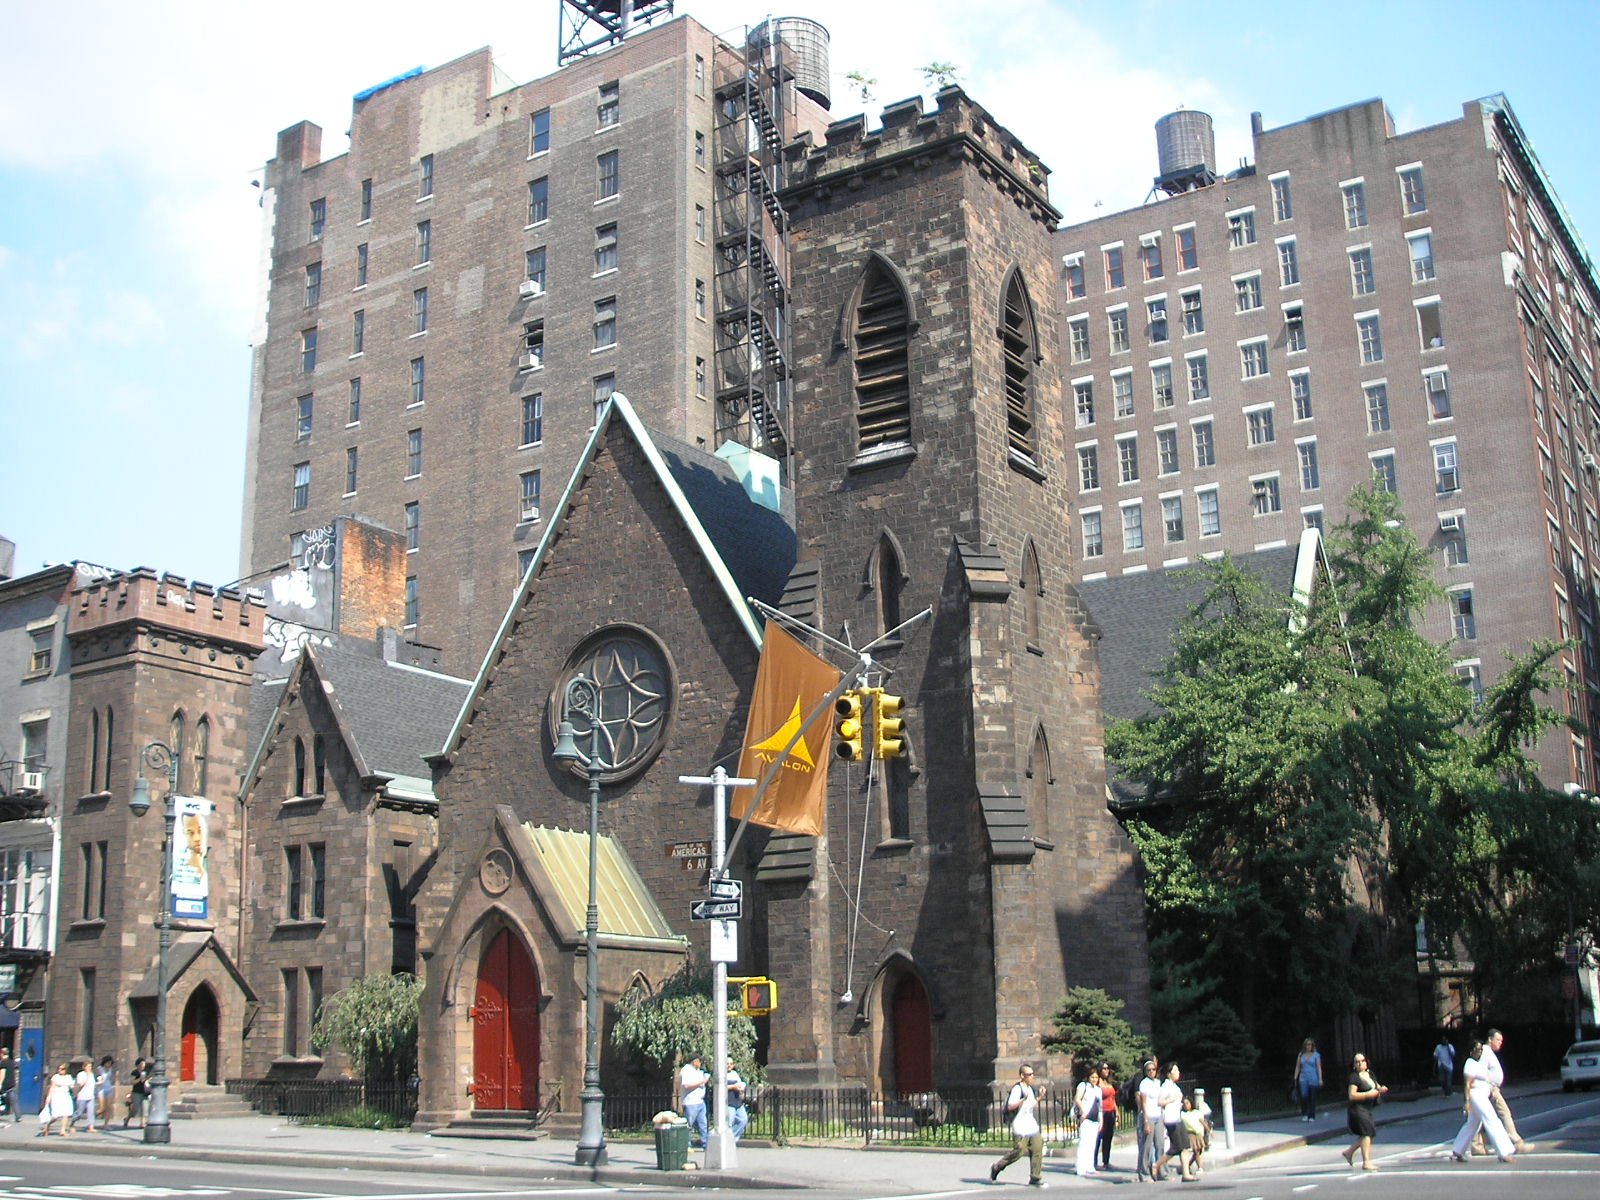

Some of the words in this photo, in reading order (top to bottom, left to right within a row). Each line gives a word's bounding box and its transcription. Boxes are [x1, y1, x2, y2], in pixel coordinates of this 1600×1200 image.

[754, 752, 811, 773] AVLON
[671, 847, 706, 857] AMERICAS
[687, 859, 693, 870] 6
[697, 858, 707, 870] AV
[697, 906, 713, 914] ONE
[719, 904, 734, 912] WAY
